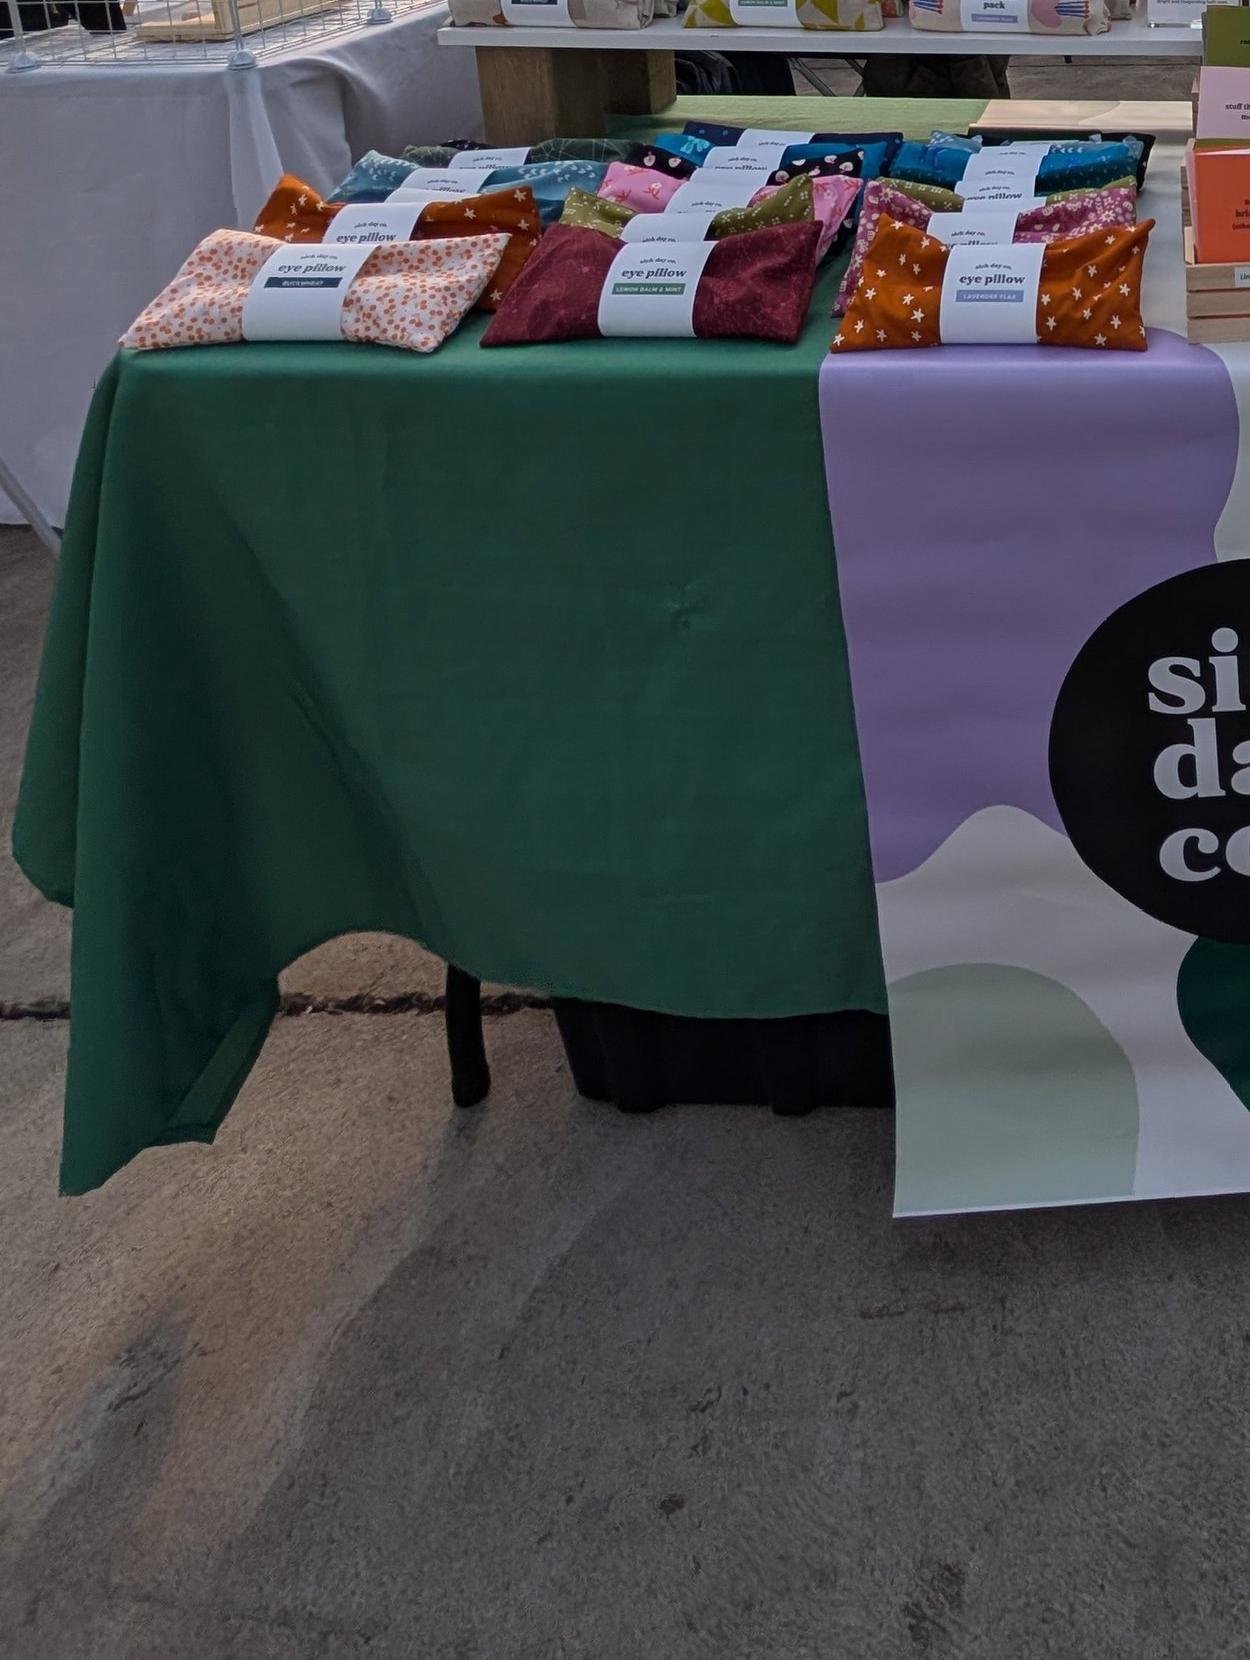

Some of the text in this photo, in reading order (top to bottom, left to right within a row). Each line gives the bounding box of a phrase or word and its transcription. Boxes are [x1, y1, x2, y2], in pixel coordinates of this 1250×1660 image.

[983, 1, 1005, 10] pack
[336, 233, 396, 244] eye pillow
[278, 263, 346, 273] eye pillow
[621, 268, 687, 278] eye pillow
[959, 274, 1026, 286] eye pillow
